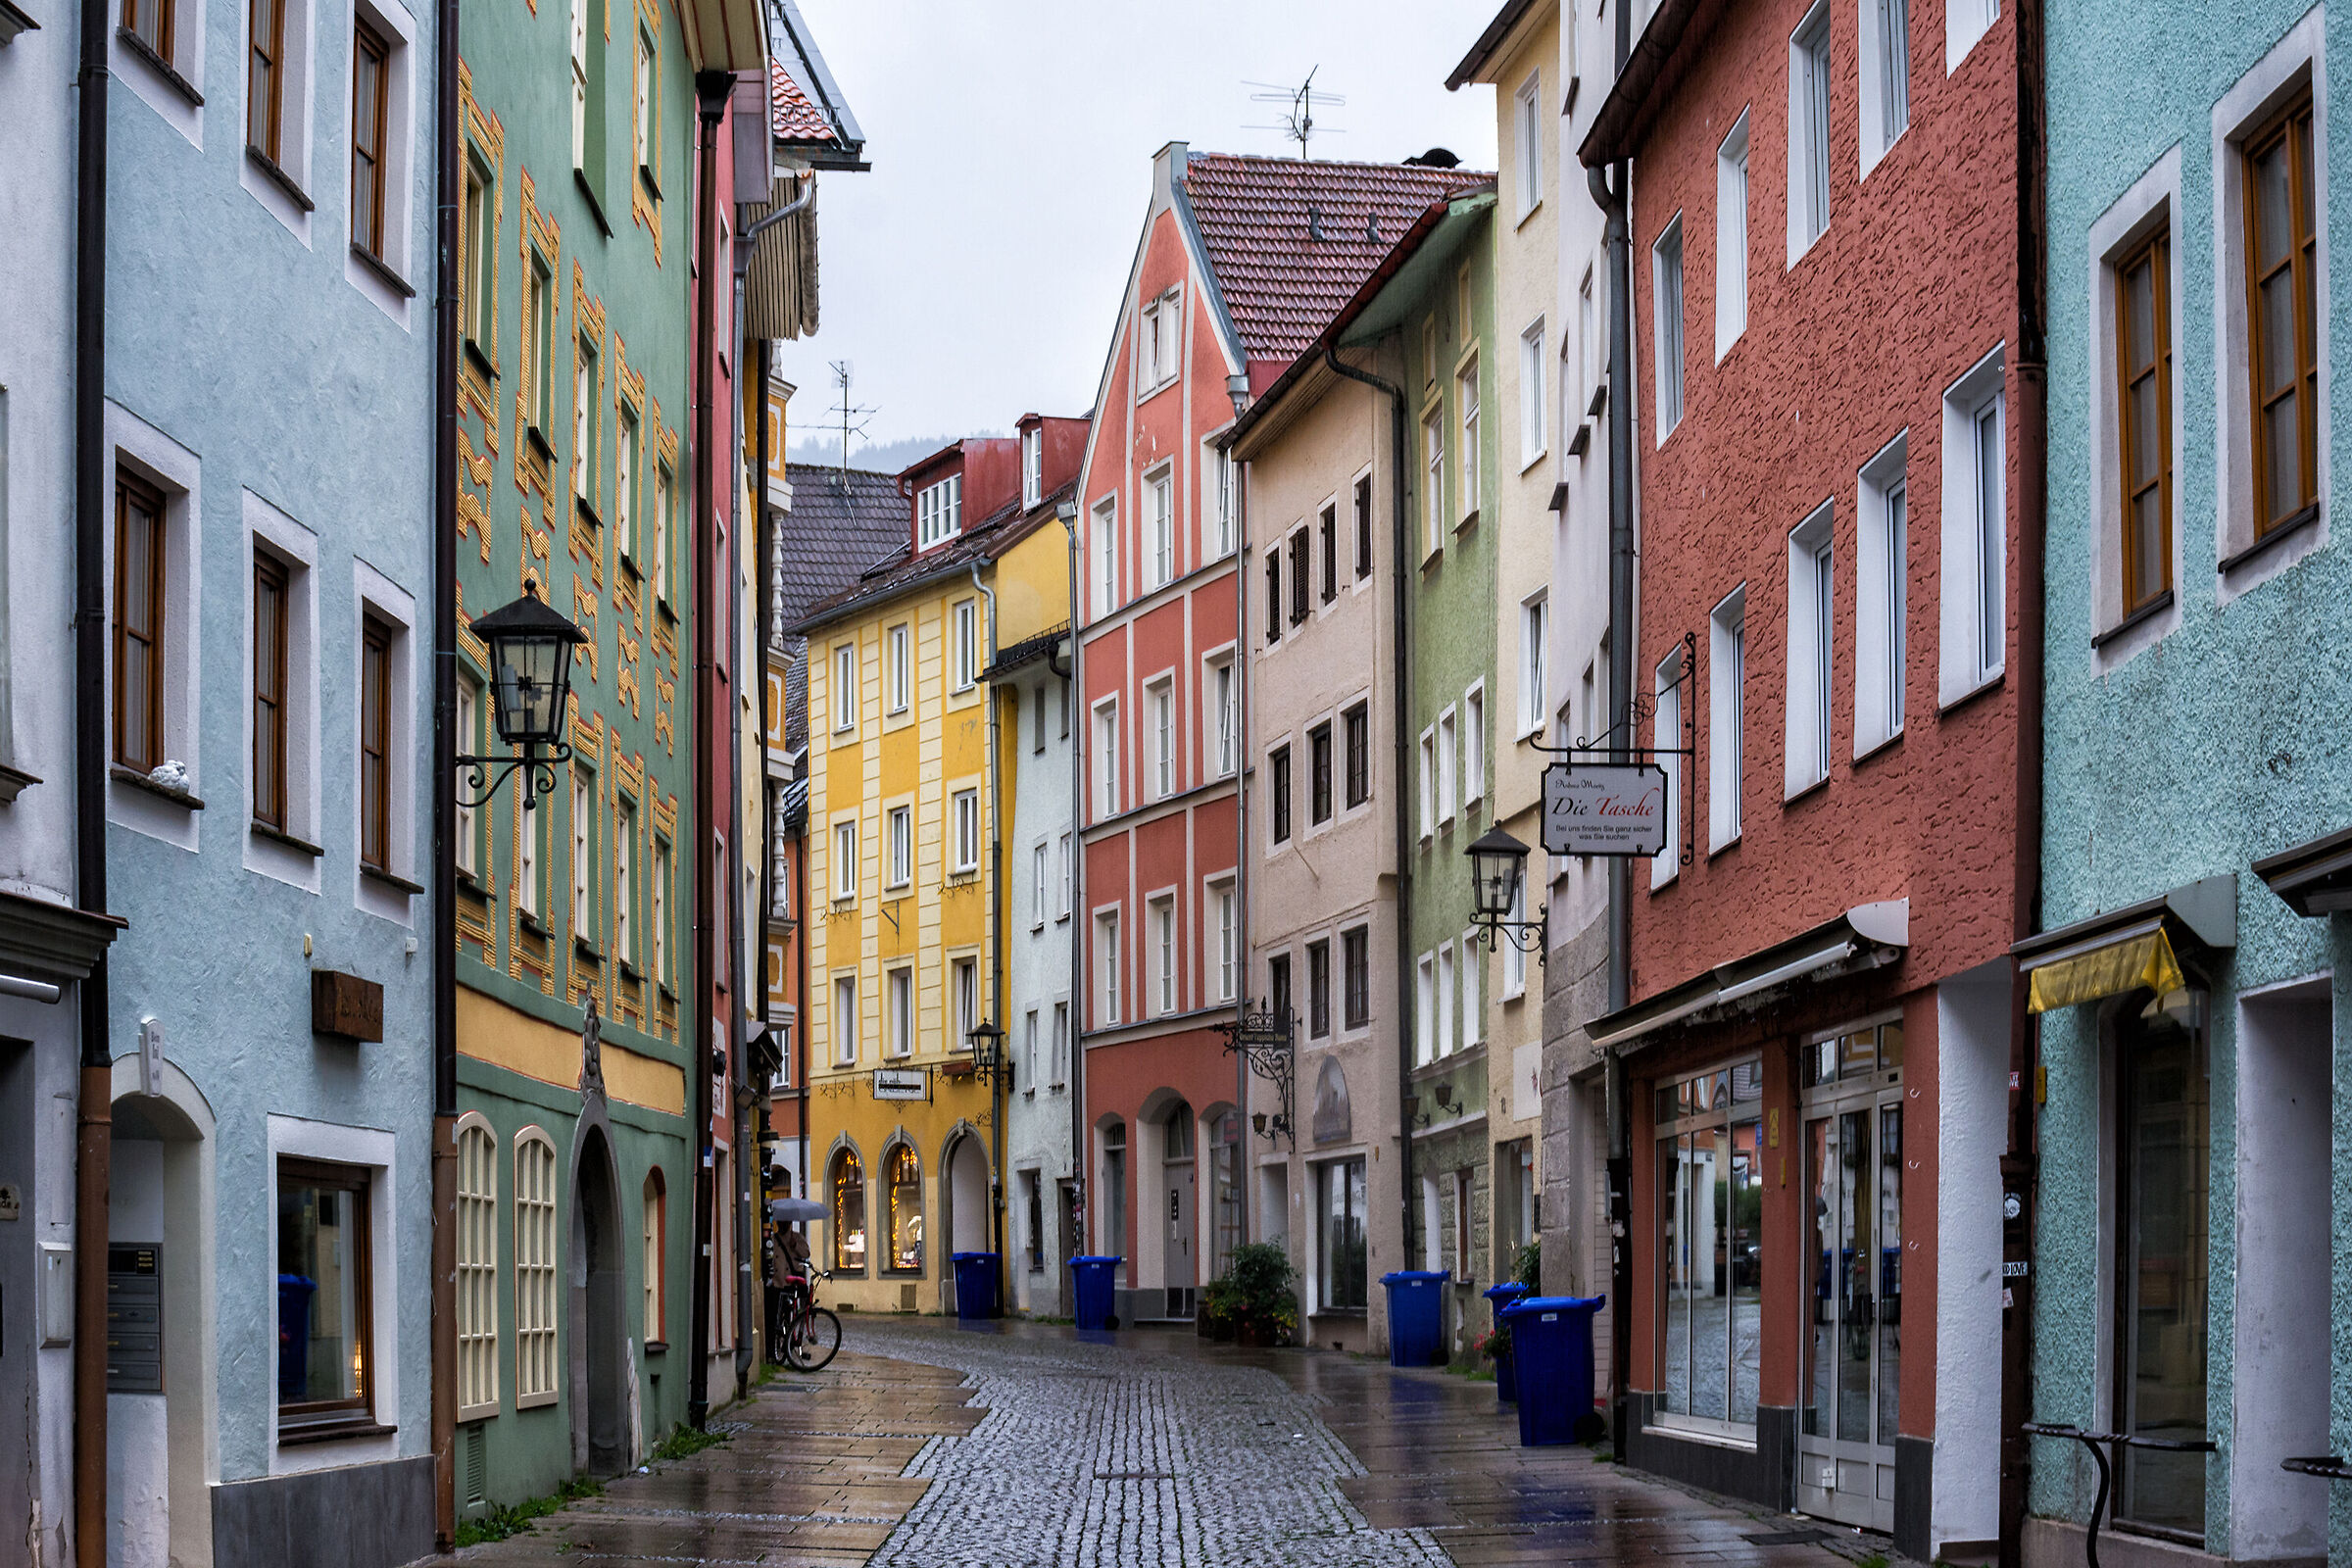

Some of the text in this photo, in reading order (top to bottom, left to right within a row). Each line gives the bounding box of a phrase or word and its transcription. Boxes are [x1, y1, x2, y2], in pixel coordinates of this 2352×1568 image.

[1552, 787, 1660, 816] Die Tasche
[1615, 825, 1632, 834] ganz
